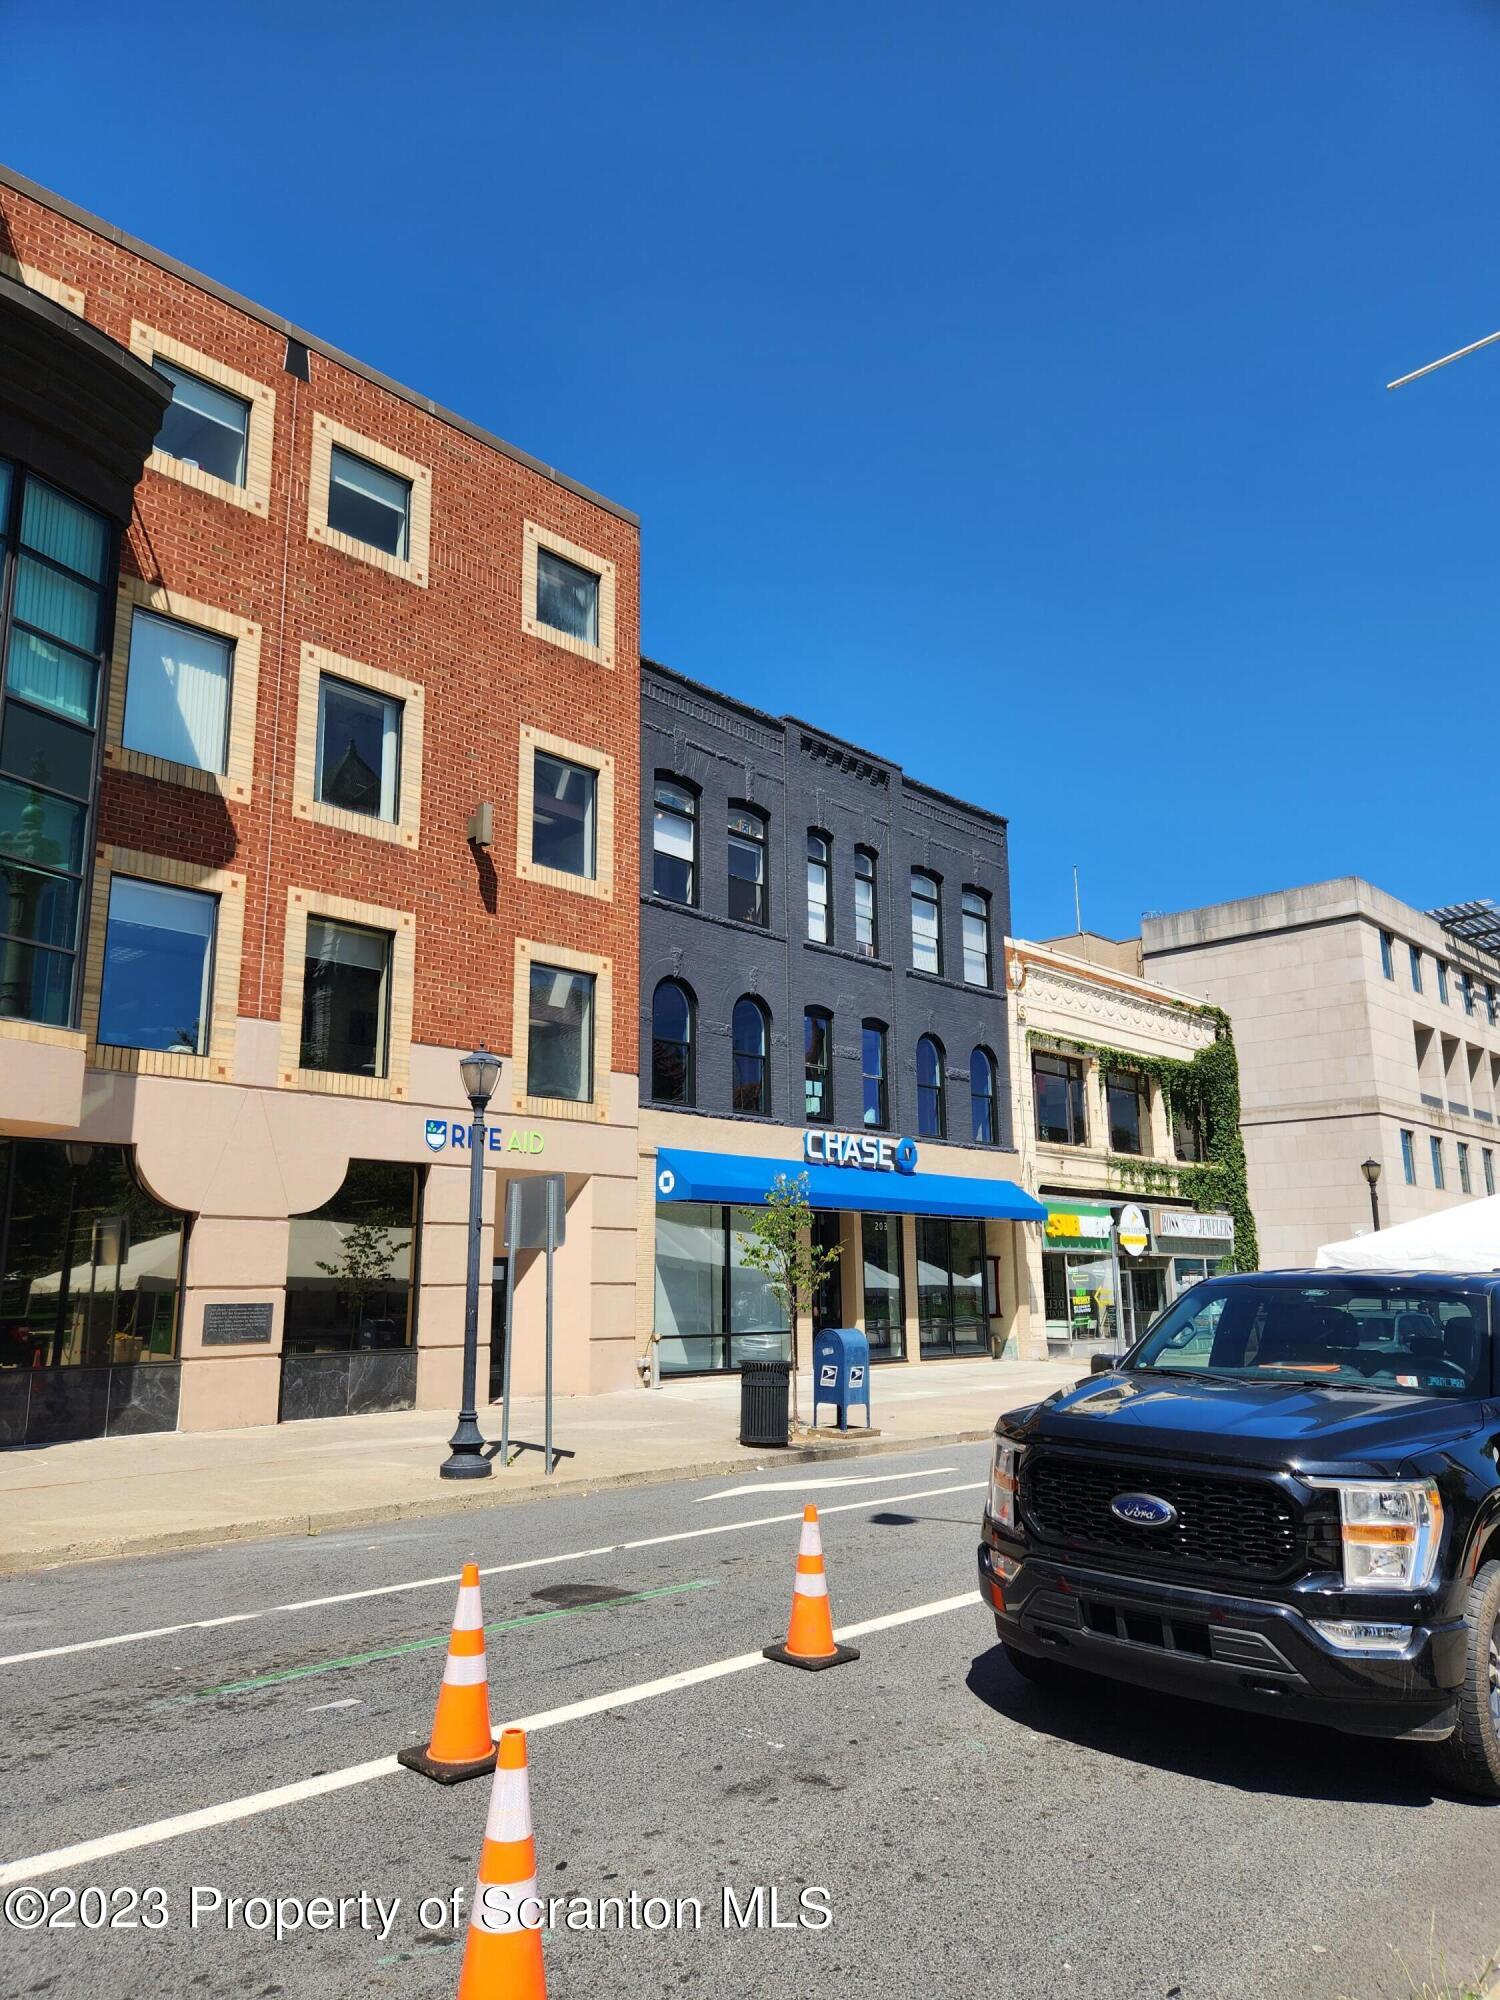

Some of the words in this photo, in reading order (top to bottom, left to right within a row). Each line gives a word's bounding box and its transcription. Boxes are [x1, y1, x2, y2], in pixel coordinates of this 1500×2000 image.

[507, 1130, 544, 1154] AID
[804, 1131, 894, 1168] CHASE
[875, 1221, 887, 1231] 203
[1124, 1503, 1156, 1519] Ford
